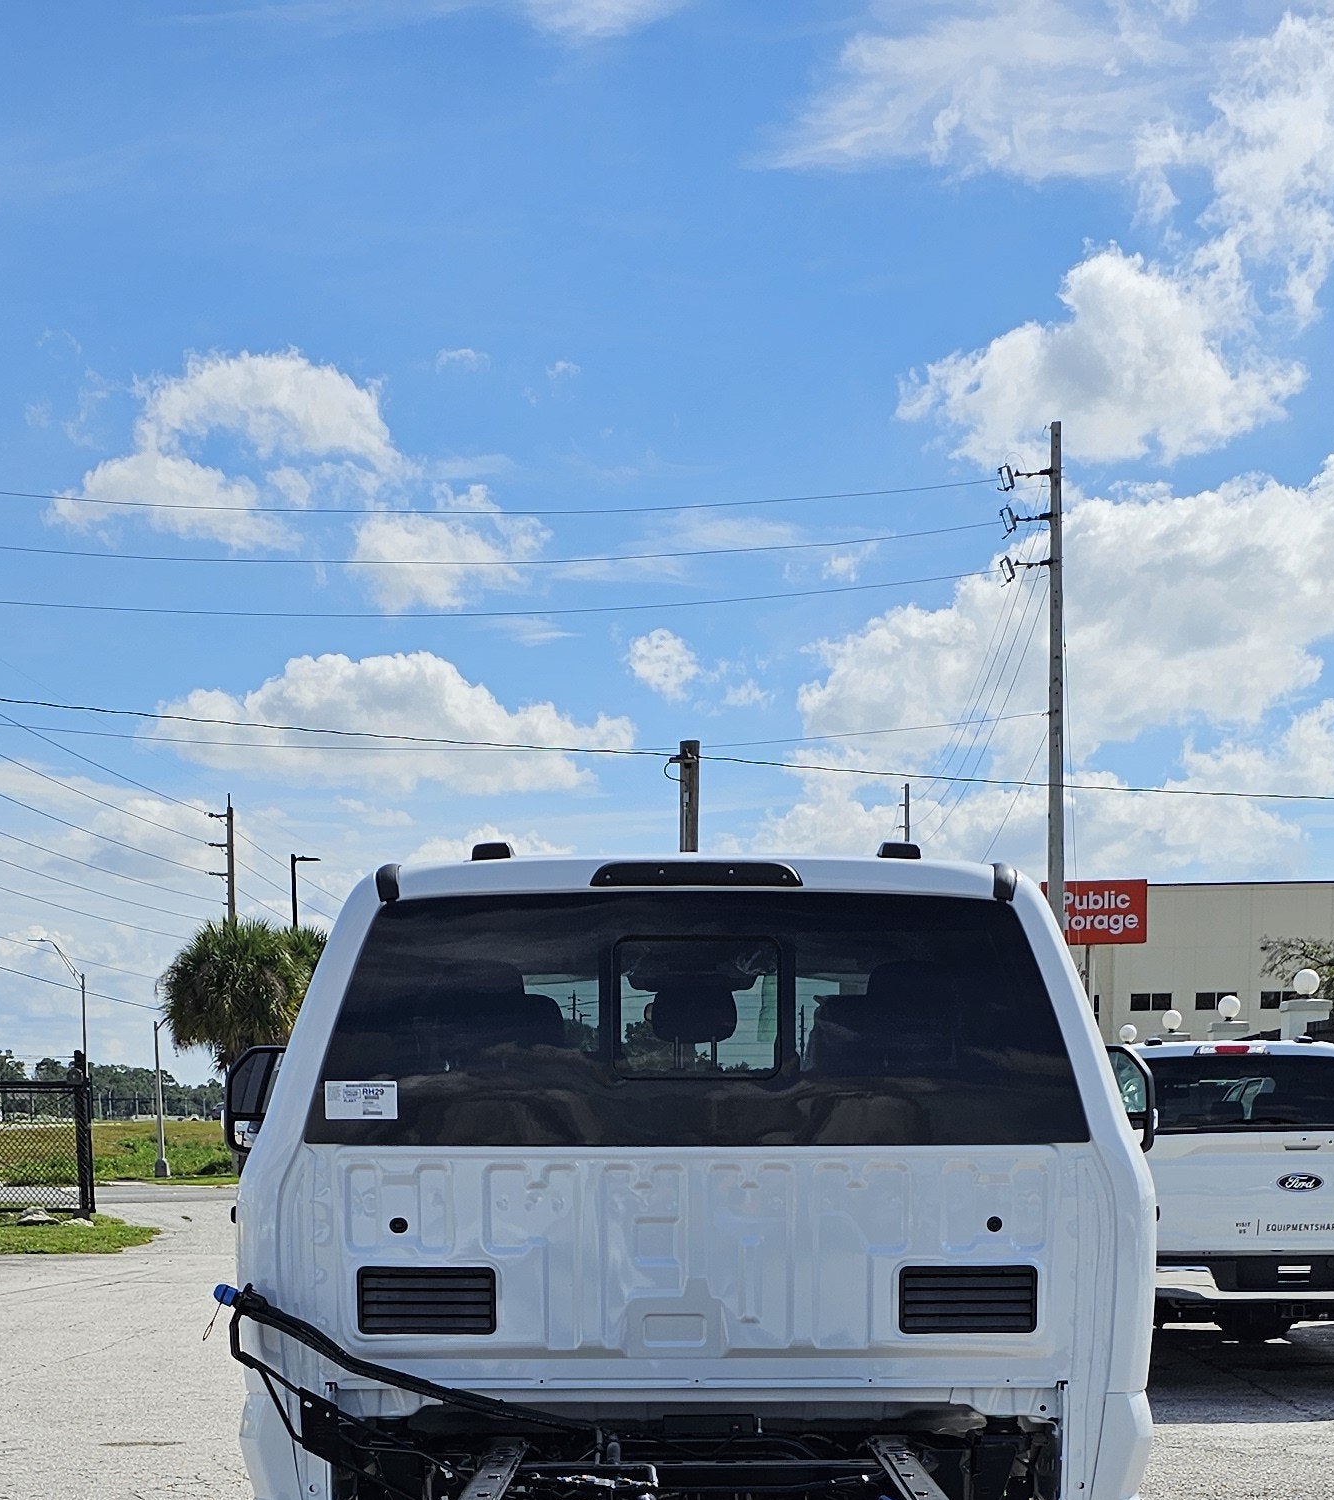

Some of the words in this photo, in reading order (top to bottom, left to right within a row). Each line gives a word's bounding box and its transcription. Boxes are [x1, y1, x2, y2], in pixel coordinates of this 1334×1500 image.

[1063, 890, 1131, 910] Public
[1063, 911, 1139, 935] torage
[1284, 1175, 1317, 1189] Ford
